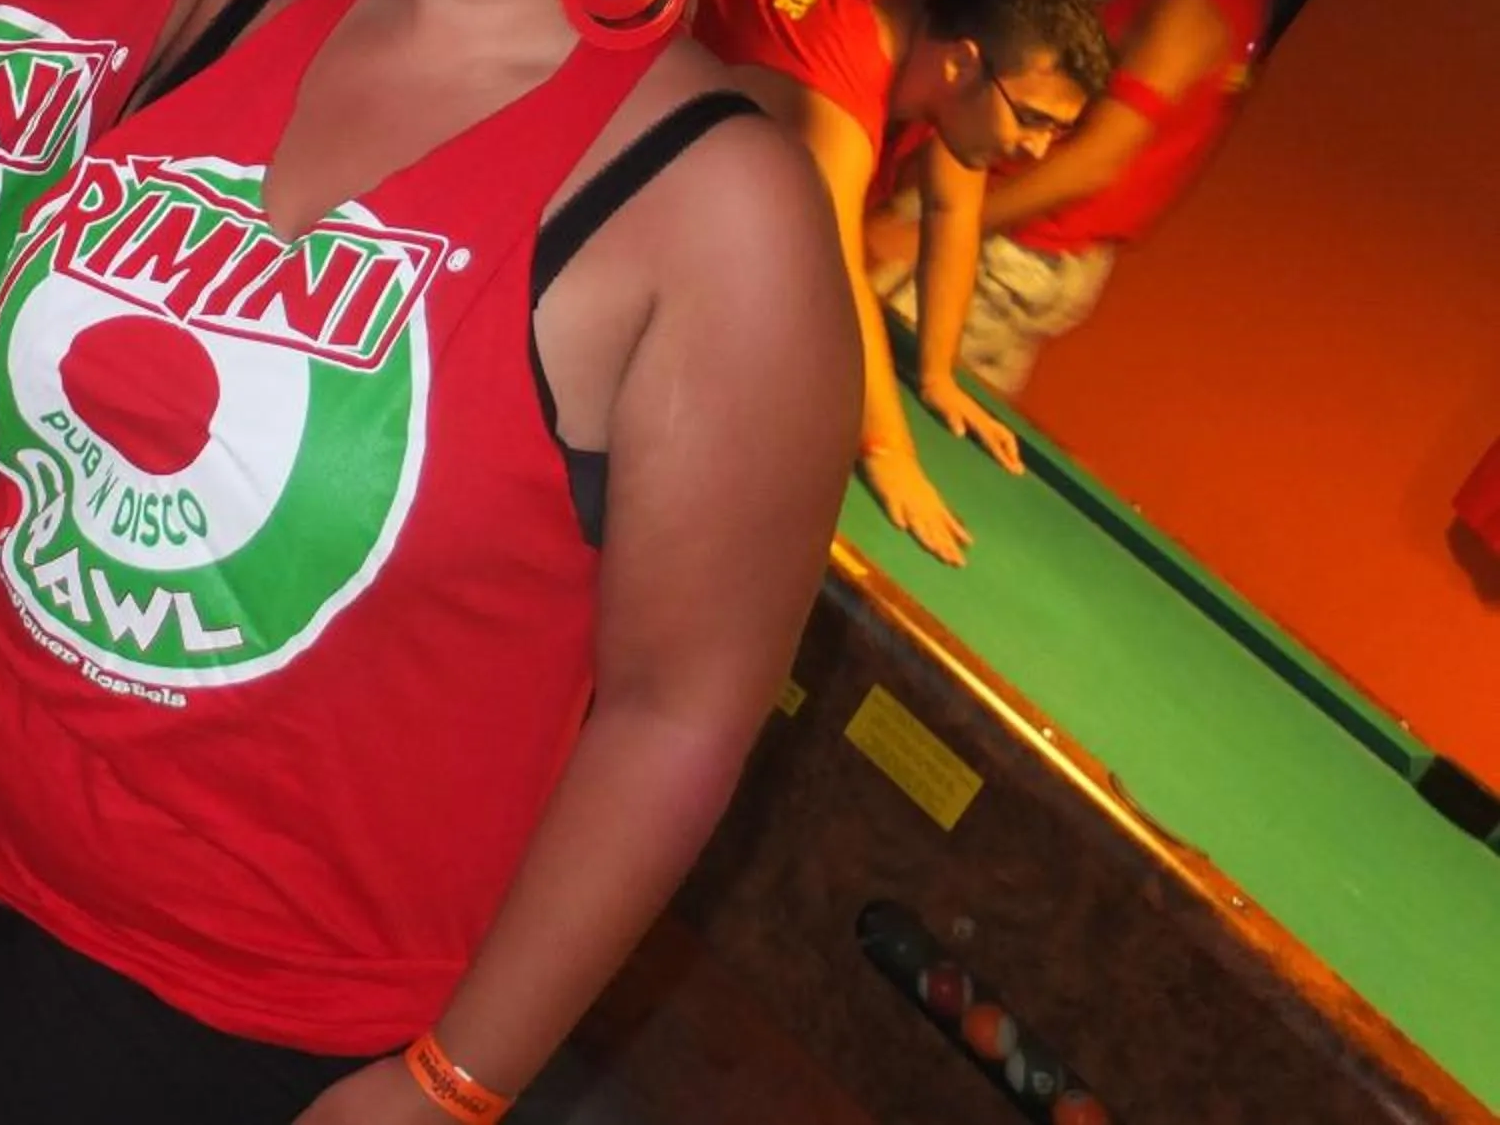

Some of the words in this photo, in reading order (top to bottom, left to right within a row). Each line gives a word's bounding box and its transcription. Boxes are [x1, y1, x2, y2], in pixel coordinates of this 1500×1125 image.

[42, 156, 403, 352] RIMINI
[16, 447, 244, 652] CRAWL
[40, 410, 103, 478] PUB
[111, 486, 208, 547] DISCO
